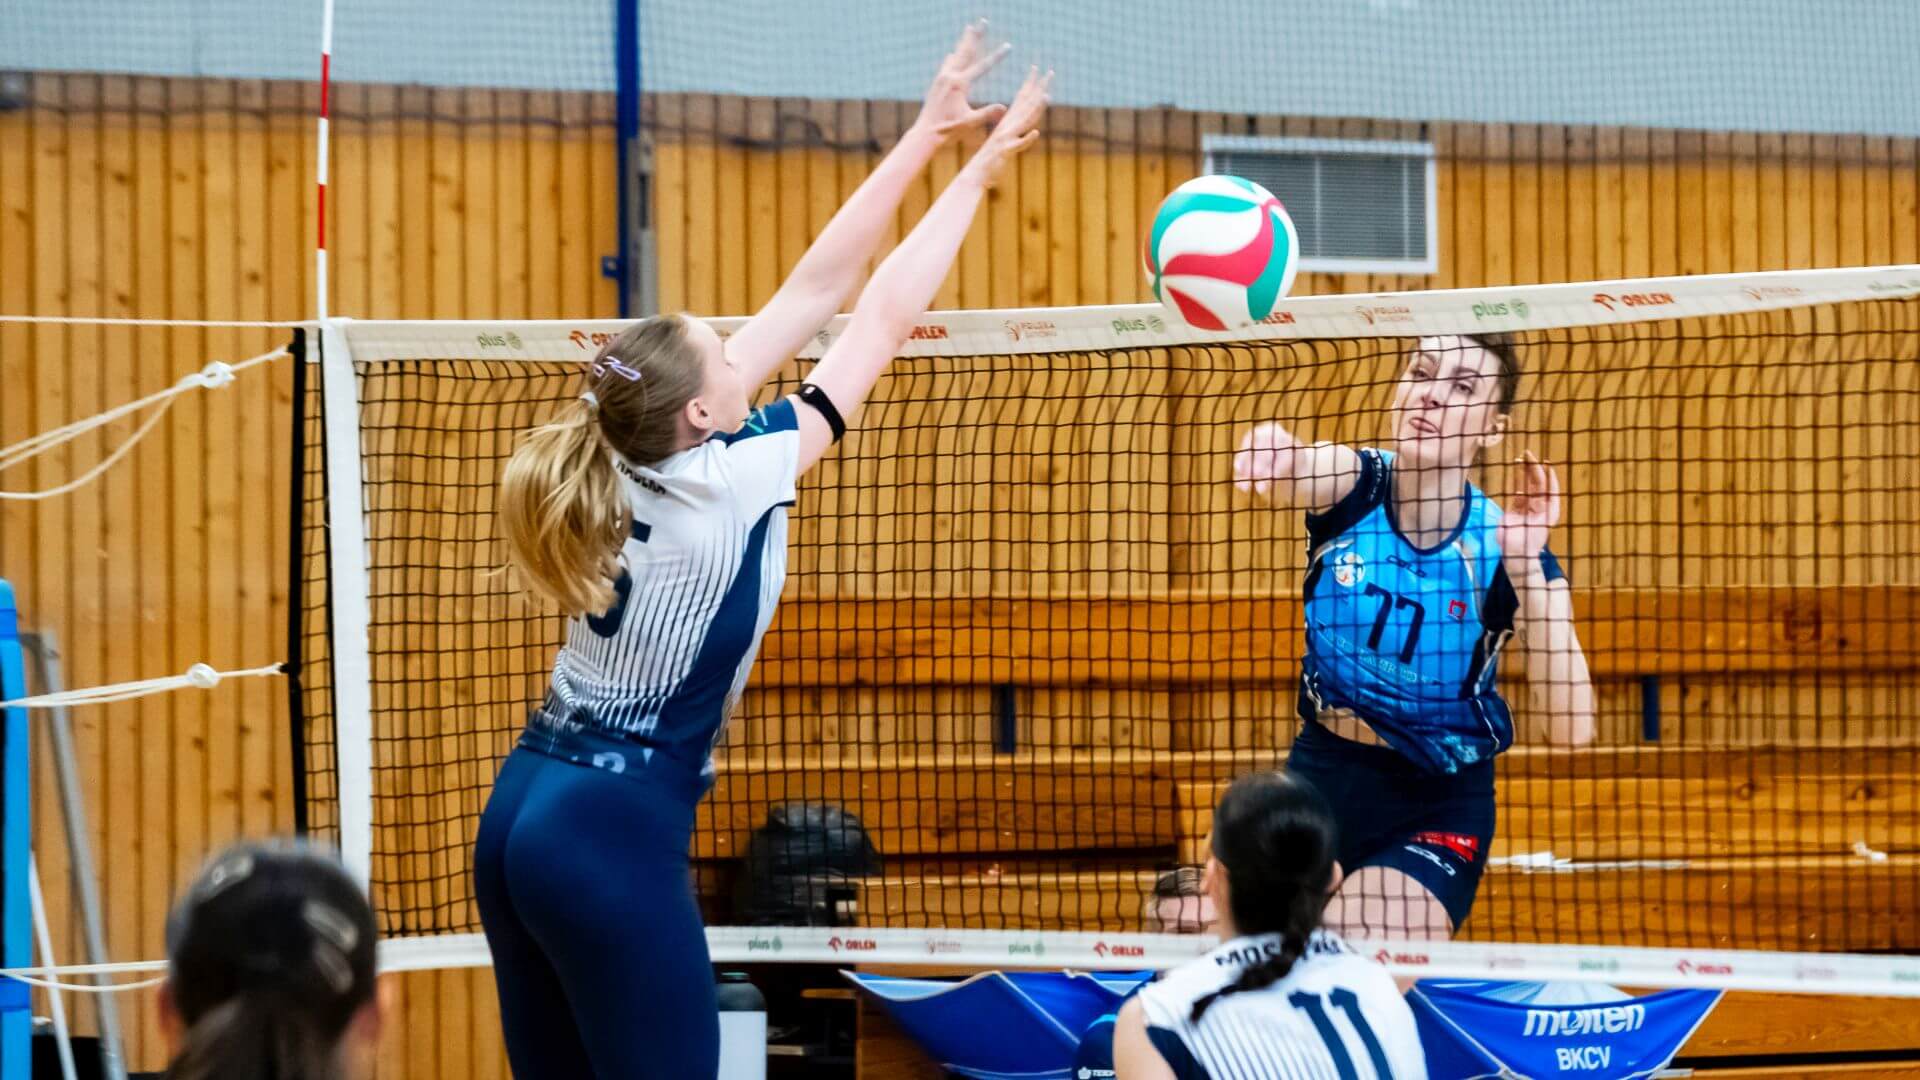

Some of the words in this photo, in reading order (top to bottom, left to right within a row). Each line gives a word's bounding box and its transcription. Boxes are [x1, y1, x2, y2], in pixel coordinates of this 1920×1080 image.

[1620, 292, 1676, 307] ORLEN
[1471, 300, 1509, 320] plus
[909, 325, 949, 340] RLEN
[1111, 317, 1147, 336] plus
[477, 331, 506, 349] plus
[1364, 582, 1426, 665] 77
[747, 936, 770, 951] plus
[845, 939, 877, 951] ORLEN
[1008, 940, 1032, 955] plus
[1111, 945, 1145, 957] ORLEN
[1523, 1003, 1646, 1037] molten
[1288, 986, 1396, 1080] 11
[1555, 1045, 1611, 1071] BKCV
